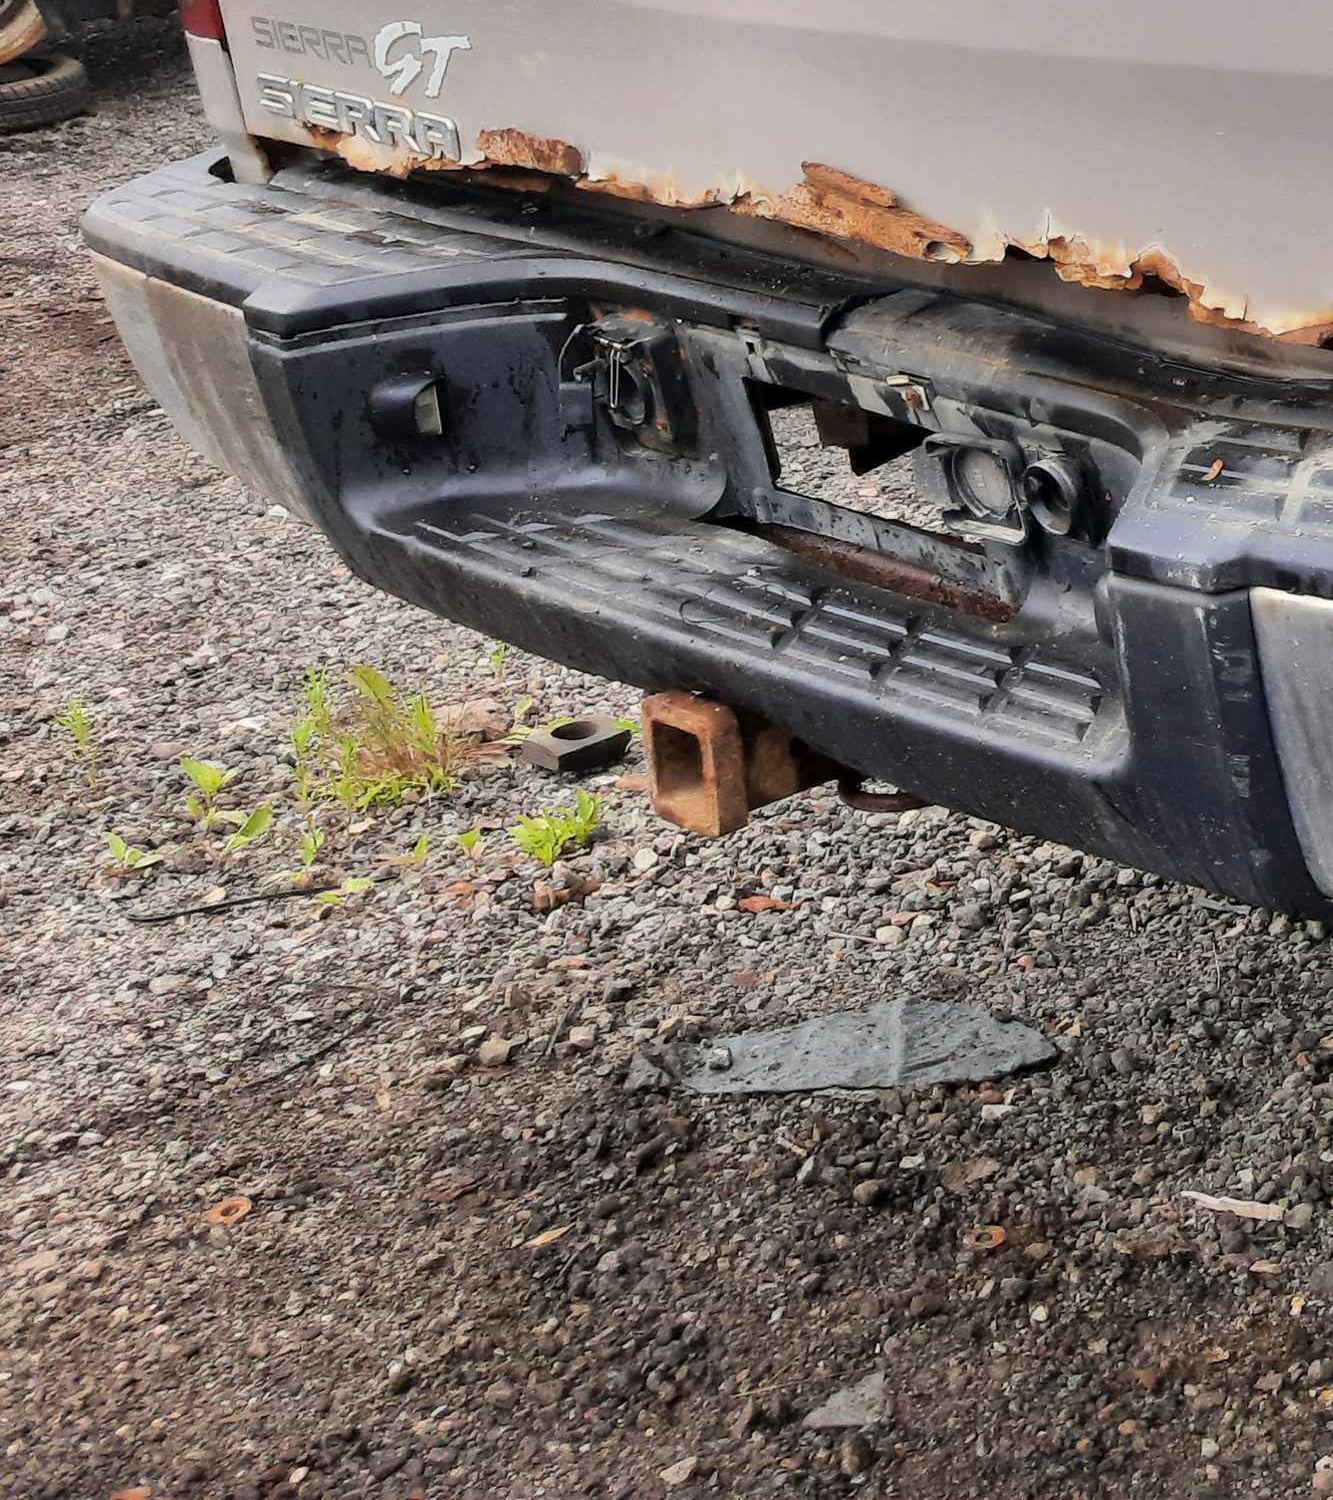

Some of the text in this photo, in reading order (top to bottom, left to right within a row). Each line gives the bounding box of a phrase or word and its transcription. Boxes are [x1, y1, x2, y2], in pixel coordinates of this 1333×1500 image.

[251, 16, 472, 99] SIERRA GT
[256, 72, 462, 164] SIERRA
